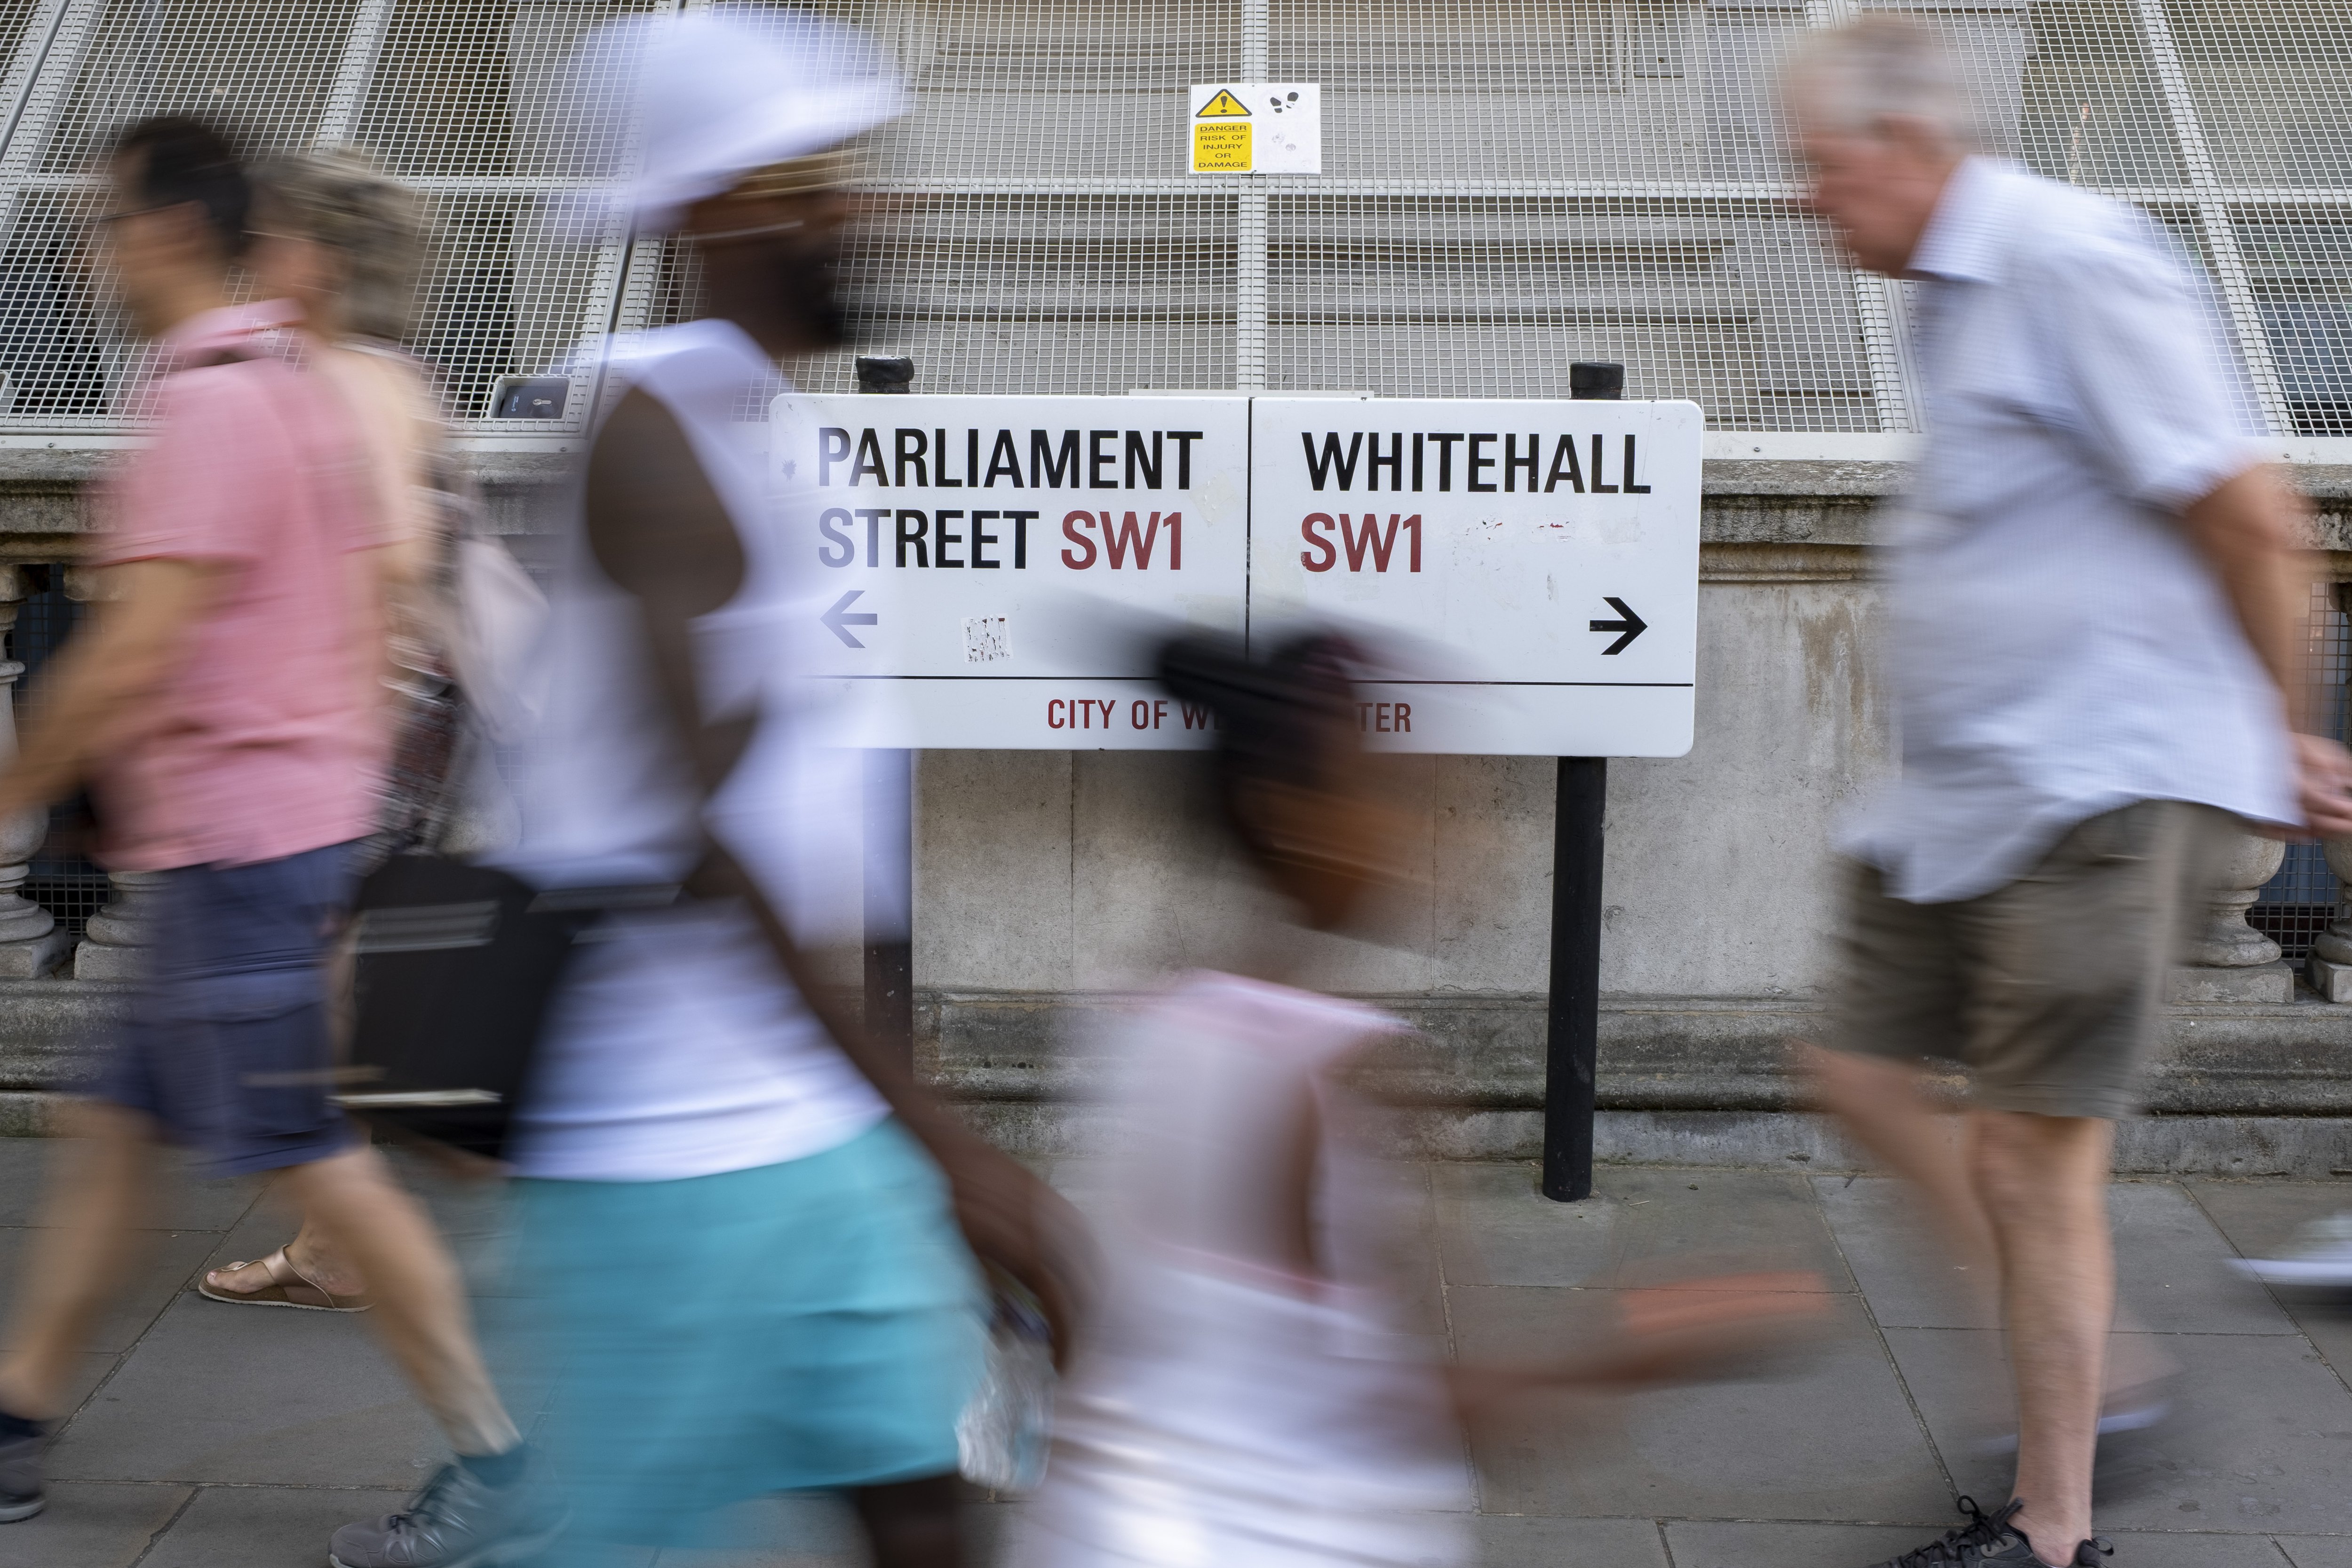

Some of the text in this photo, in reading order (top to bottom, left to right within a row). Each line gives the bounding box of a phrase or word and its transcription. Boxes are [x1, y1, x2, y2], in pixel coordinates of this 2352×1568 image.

[818, 427, 1203, 490] PARLIAMENT
[1301, 432, 1651, 494] WHITEHALL
[818, 508, 1182, 571] STREET SW1
[1301, 513, 1422, 573] SW1
[1048, 699, 1115, 729] CITY
[1132, 700, 1168, 730] OF
